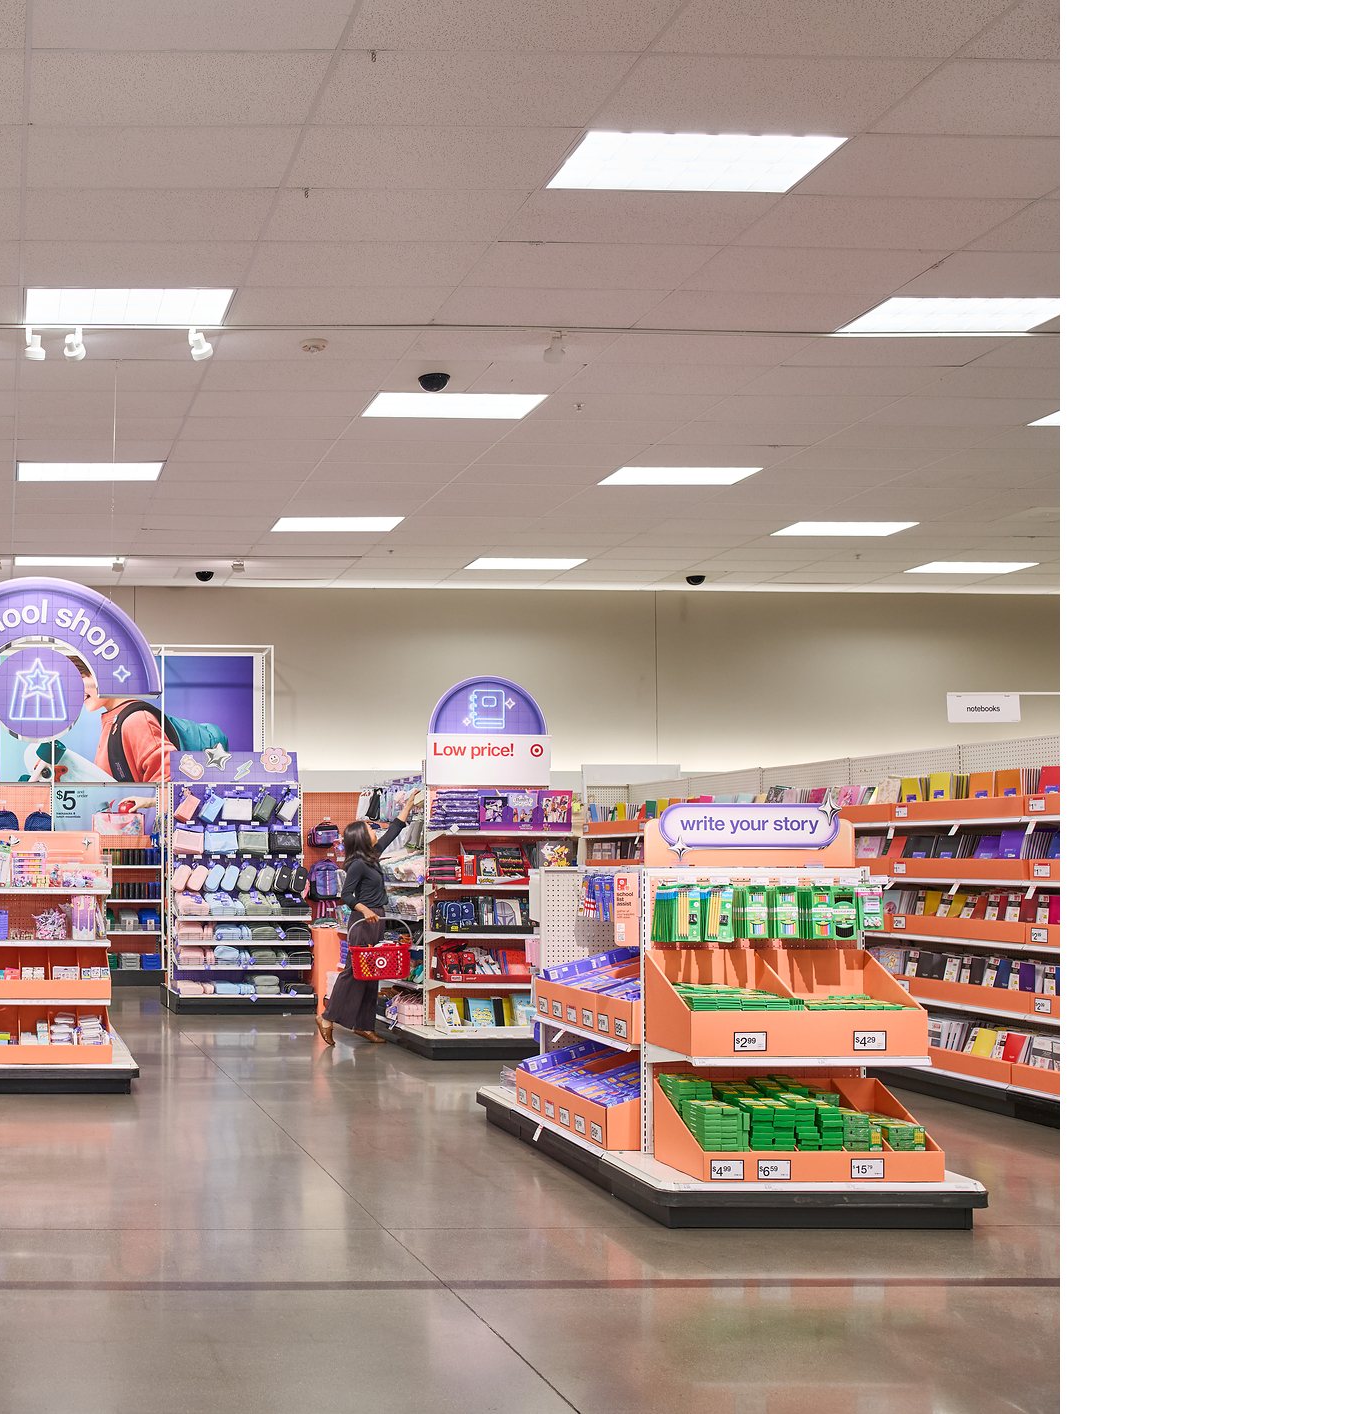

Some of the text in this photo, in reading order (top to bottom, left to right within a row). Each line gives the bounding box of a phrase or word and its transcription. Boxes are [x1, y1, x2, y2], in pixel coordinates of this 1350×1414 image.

[55, 607, 120, 661] shop
[433, 742, 514, 760] Low price!
[56, 789, 77, 811] $5
[680, 815, 819, 834] write your story
[759, 1165, 779, 1176] $659
